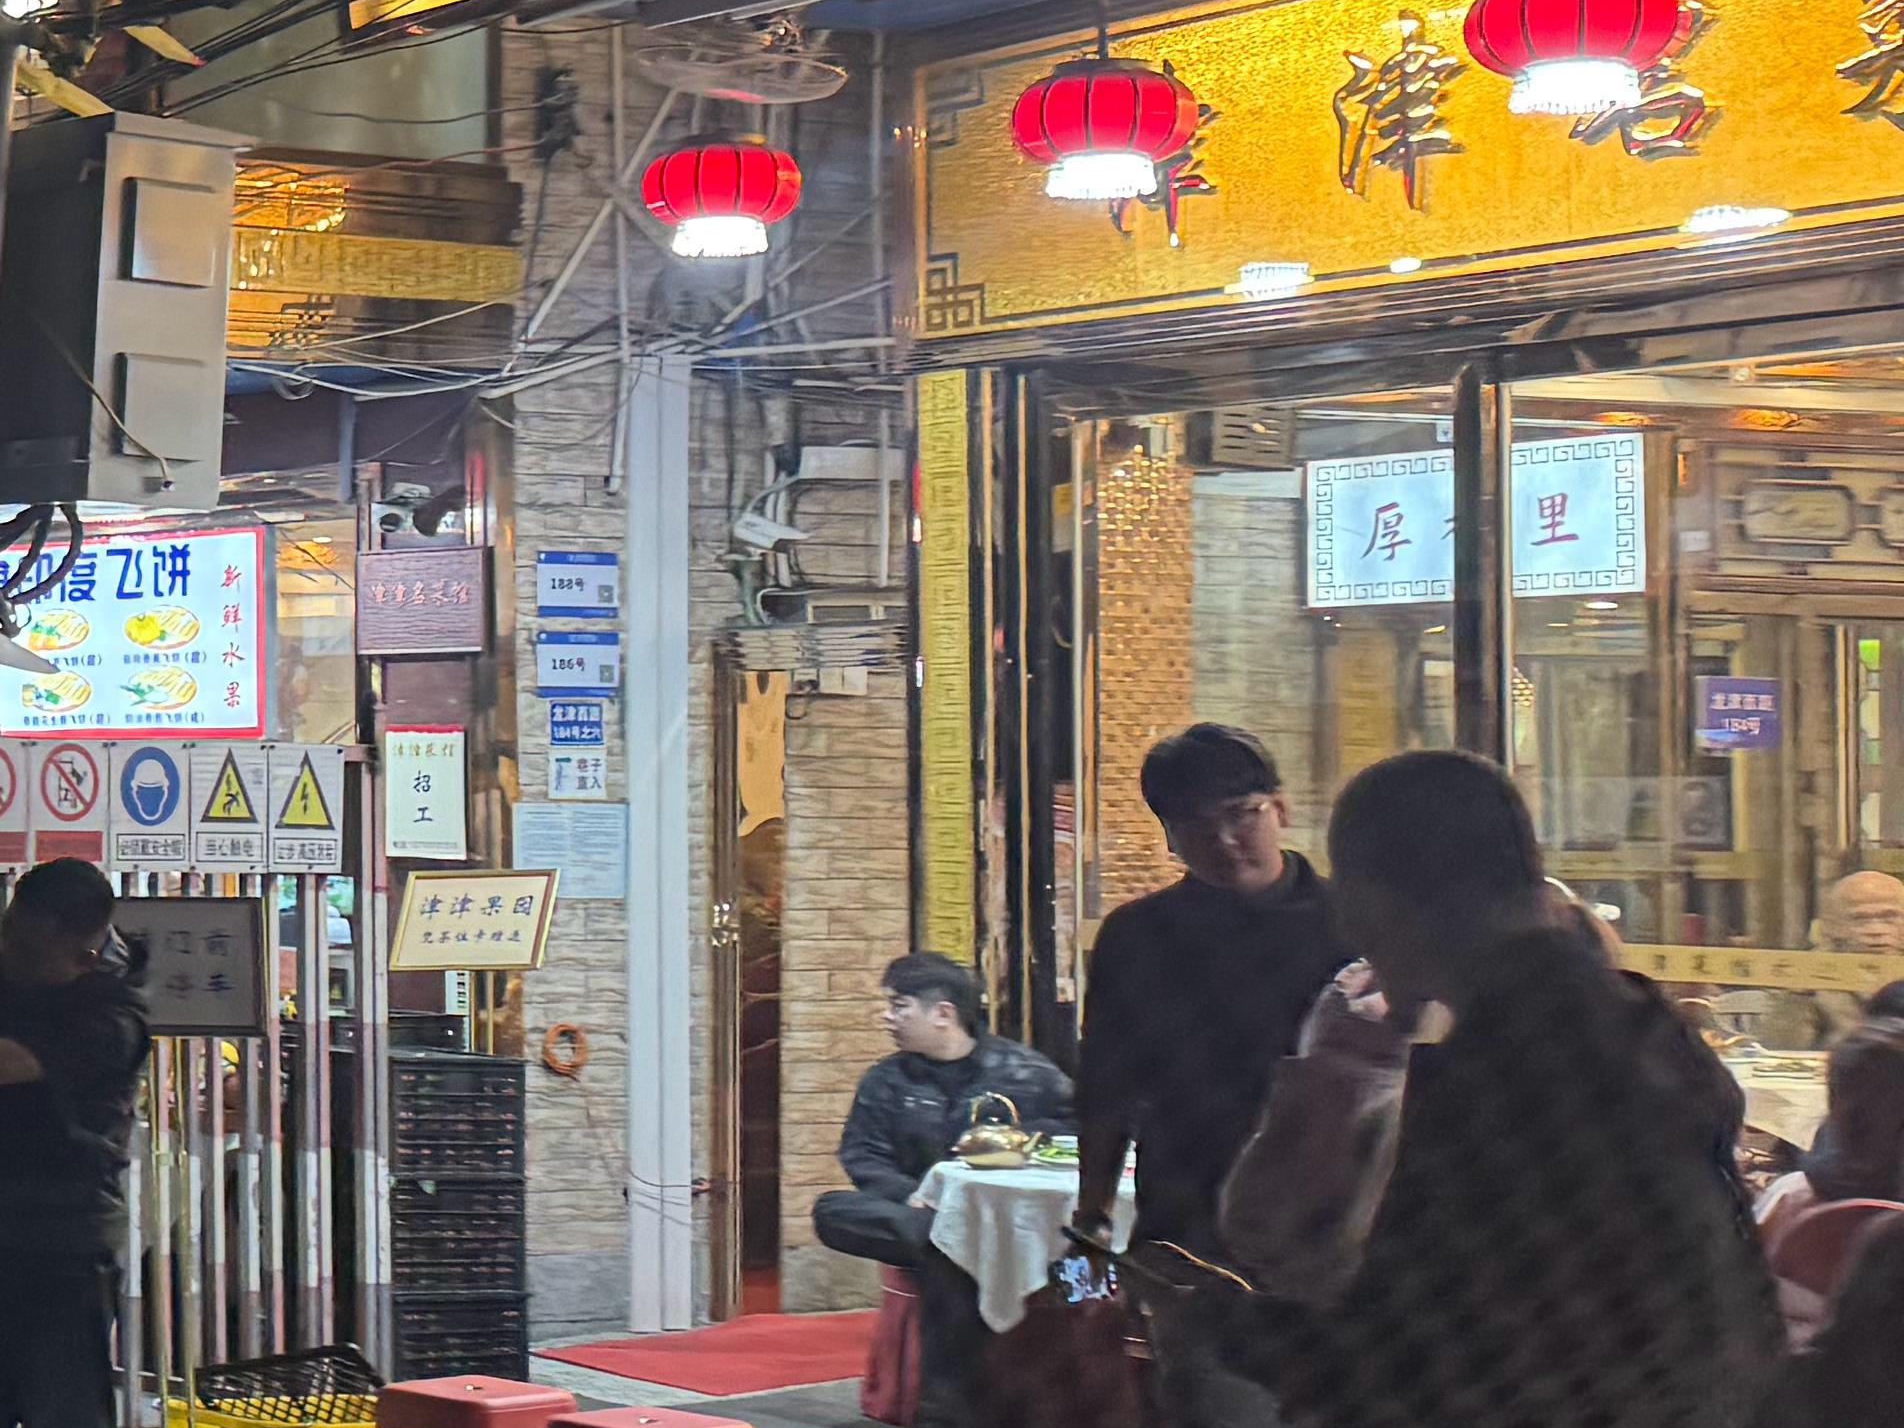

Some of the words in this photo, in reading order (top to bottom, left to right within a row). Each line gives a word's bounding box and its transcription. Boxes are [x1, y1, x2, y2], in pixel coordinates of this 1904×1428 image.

[1360, 491, 1580, 562] 厚里
[220, 563, 246, 708] 新鲜水果
[550, 656, 586, 672] 186号
[412, 770, 434, 824] 招工
[576, 774, 603, 790] 直入
[204, 838, 255, 856] 当心触电
